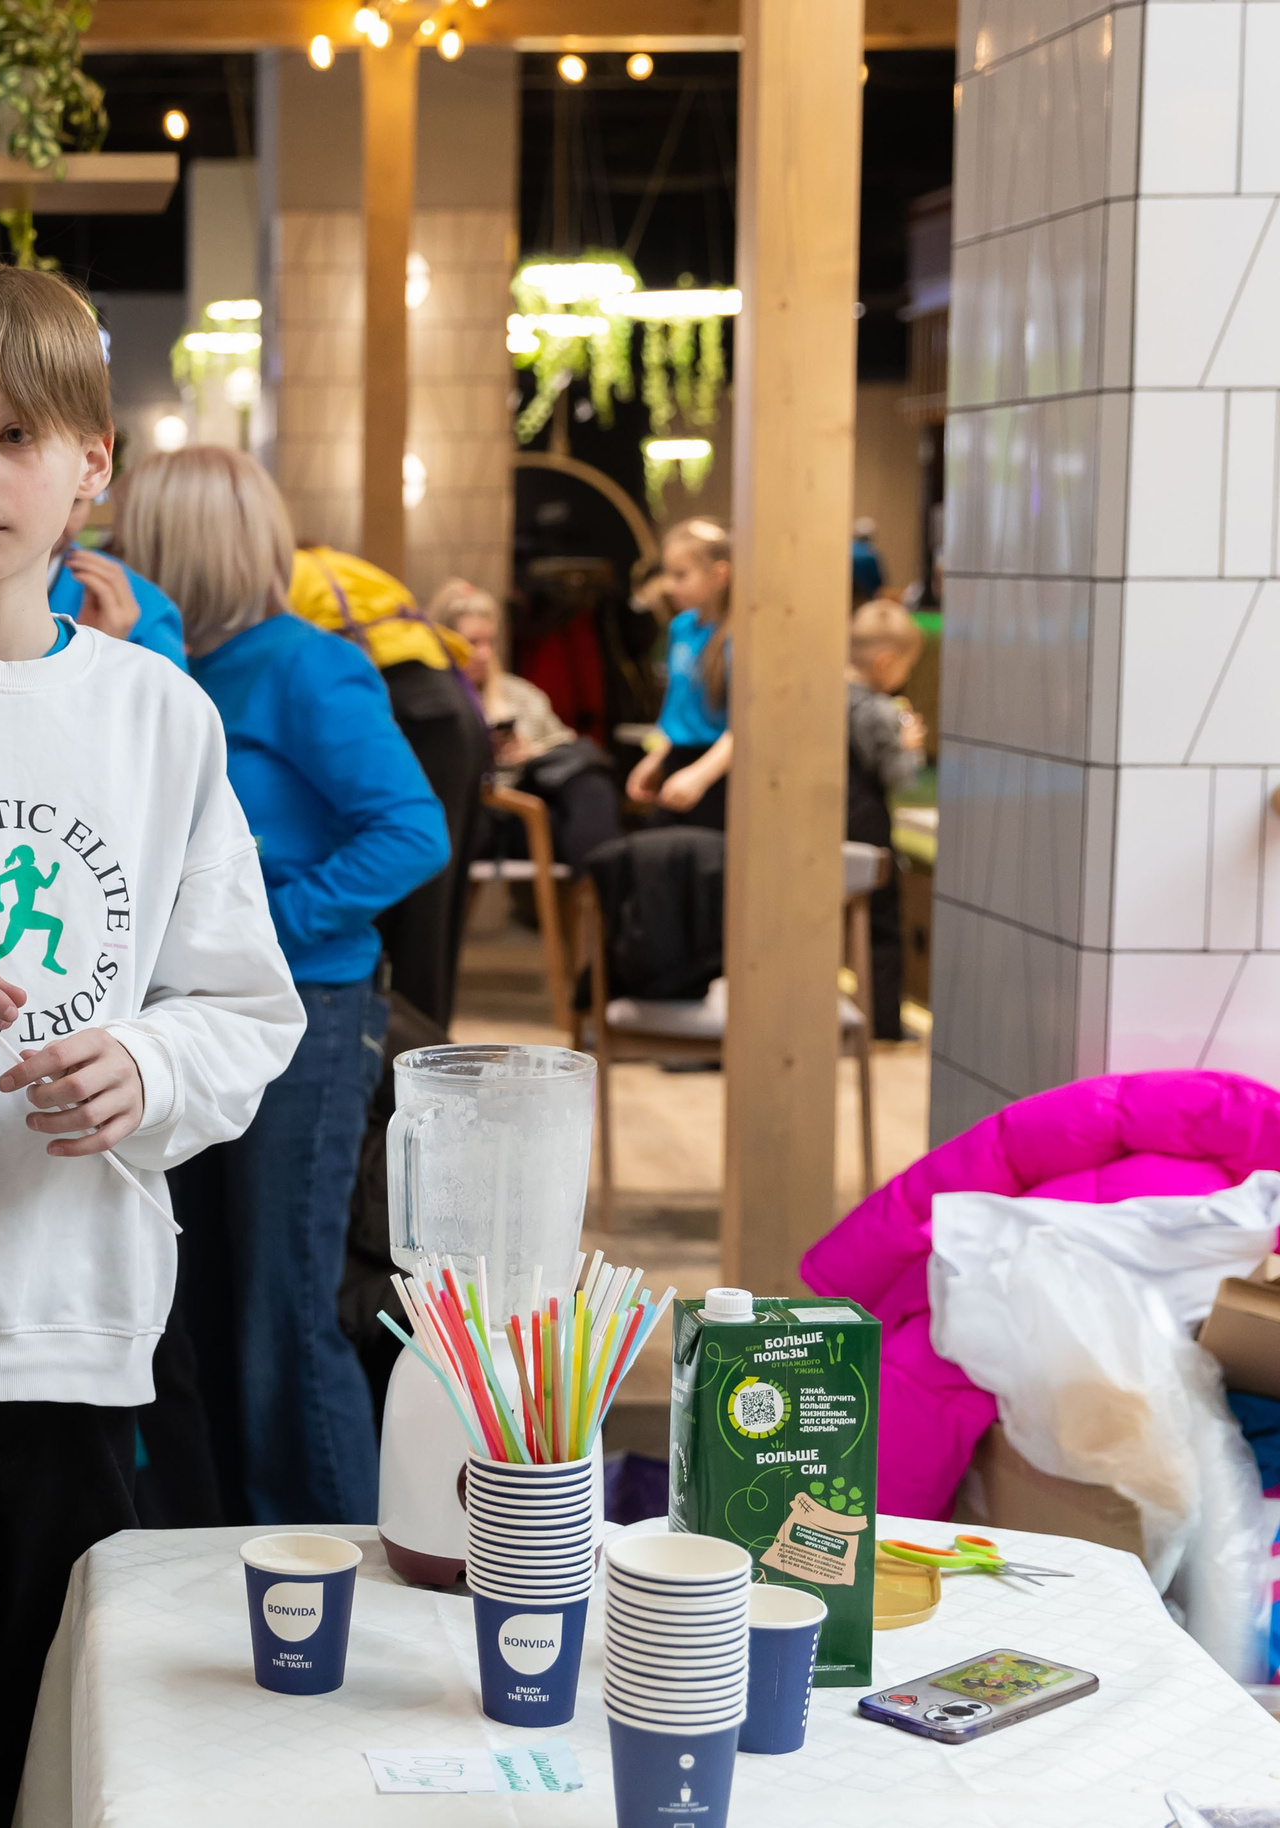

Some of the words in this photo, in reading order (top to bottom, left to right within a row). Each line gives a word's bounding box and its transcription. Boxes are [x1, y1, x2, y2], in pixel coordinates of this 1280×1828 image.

[60, 818, 130, 932] ELITE
[19, 952, 118, 1042] SPORT
[764, 1332, 824, 1349] БОЛЬШЕ
[754, 1347, 808, 1363] ПОЛЬЗЫ
[799, 1424, 838, 1433] «ДОБРЫЙ»
[756, 1449, 819, 1464] БОЛЬШЕ
[800, 1464, 827, 1474] СИЛ
[796, 1531, 817, 1542] СОЧНЫХ
[821, 1540, 841, 1550] СПЕЛЫХ
[268, 1604, 316, 1616] BONVIDA
[504, 1636, 555, 1648] BONVIDA
[280, 1652, 304, 1660] ENJOY
[272, 1659, 285, 1667] THE
[516, 1686, 541, 1694] ENJOY
[507, 1693, 522, 1701] THE
